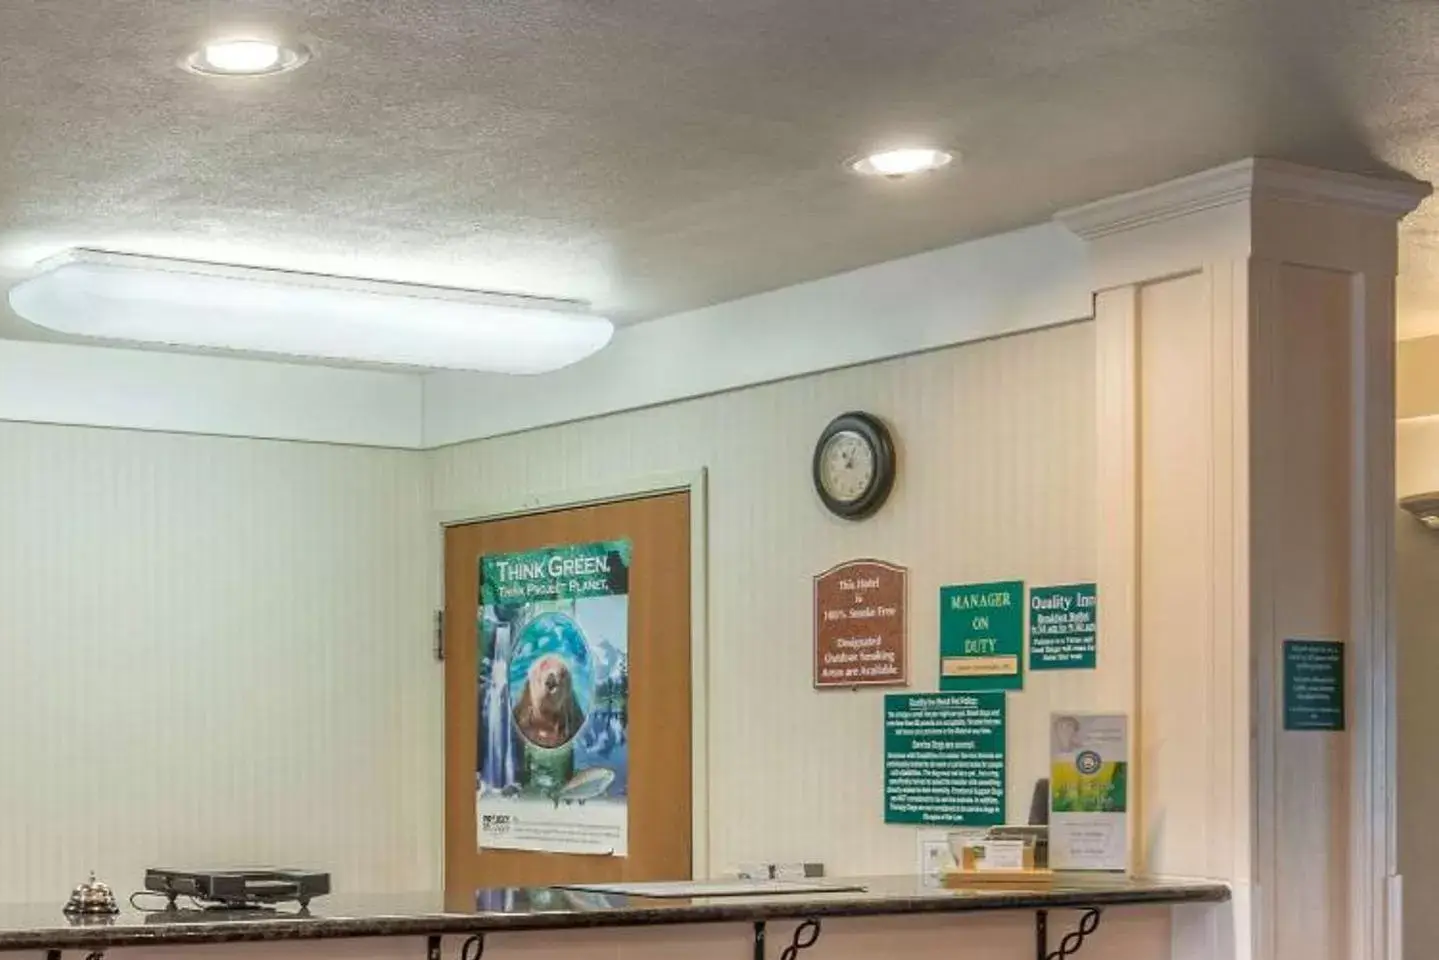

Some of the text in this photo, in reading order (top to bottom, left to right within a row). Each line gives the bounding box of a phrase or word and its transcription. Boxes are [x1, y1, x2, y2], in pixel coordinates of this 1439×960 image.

[496, 555, 611, 582] THINK GREEN.
[951, 592, 1012, 610] MANAGER
[1031, 594, 1073, 611] Quality
[972, 616, 990, 631] ON
[964, 638, 997, 654] DUTY
